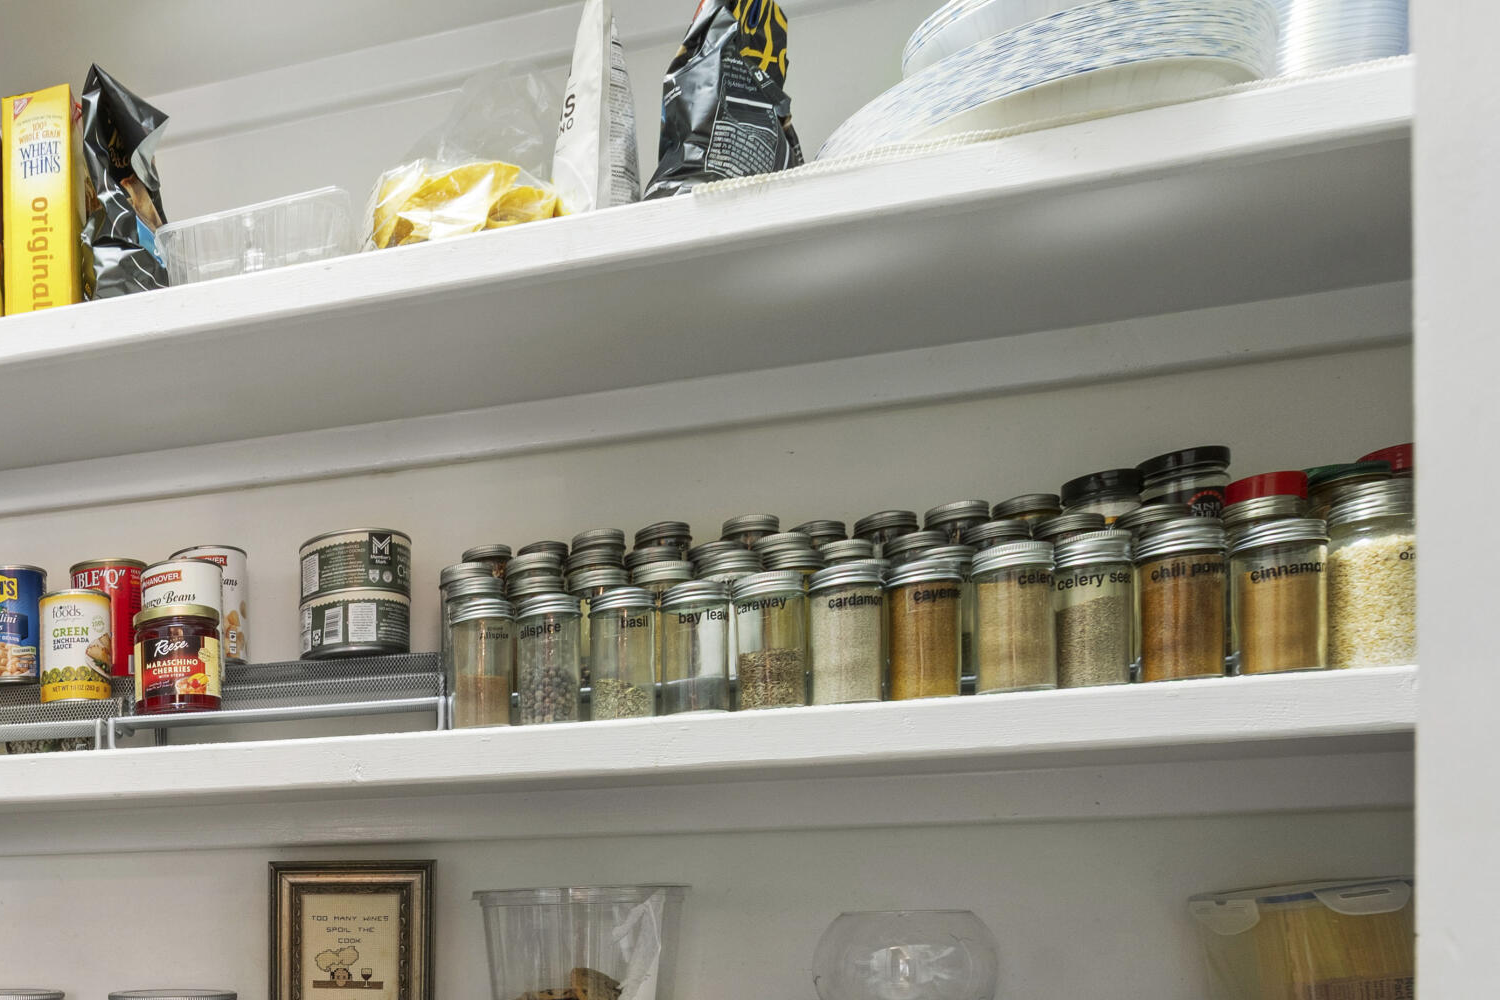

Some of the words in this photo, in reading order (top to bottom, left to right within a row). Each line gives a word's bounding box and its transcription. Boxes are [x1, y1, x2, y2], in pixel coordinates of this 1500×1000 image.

[19, 141, 61, 160] WHEAT
[21, 155, 61, 179] THINS
[26, 197, 54, 310] original
[1151, 562, 1186, 582] chili
[143, 572, 180, 589] HANOVER
[1057, 572, 1105, 591] celery
[162, 590, 196, 604] Beans
[52, 604, 81, 619] foods
[736, 597, 787, 615] caraway
[620, 615, 649, 630] basil
[678, 611, 702, 625] bay
[52, 626, 89, 638] GREEN
[479, 632, 509, 641] Allspice
[520, 622, 561, 640] allspice
[53, 637, 90, 645] ENCHILADA
[53, 643, 72, 651] SAUCE
[154, 639, 187, 657] Reese
[146, 658, 198, 670] MARASCHINO
[152, 665, 191, 675] CHERRIES
